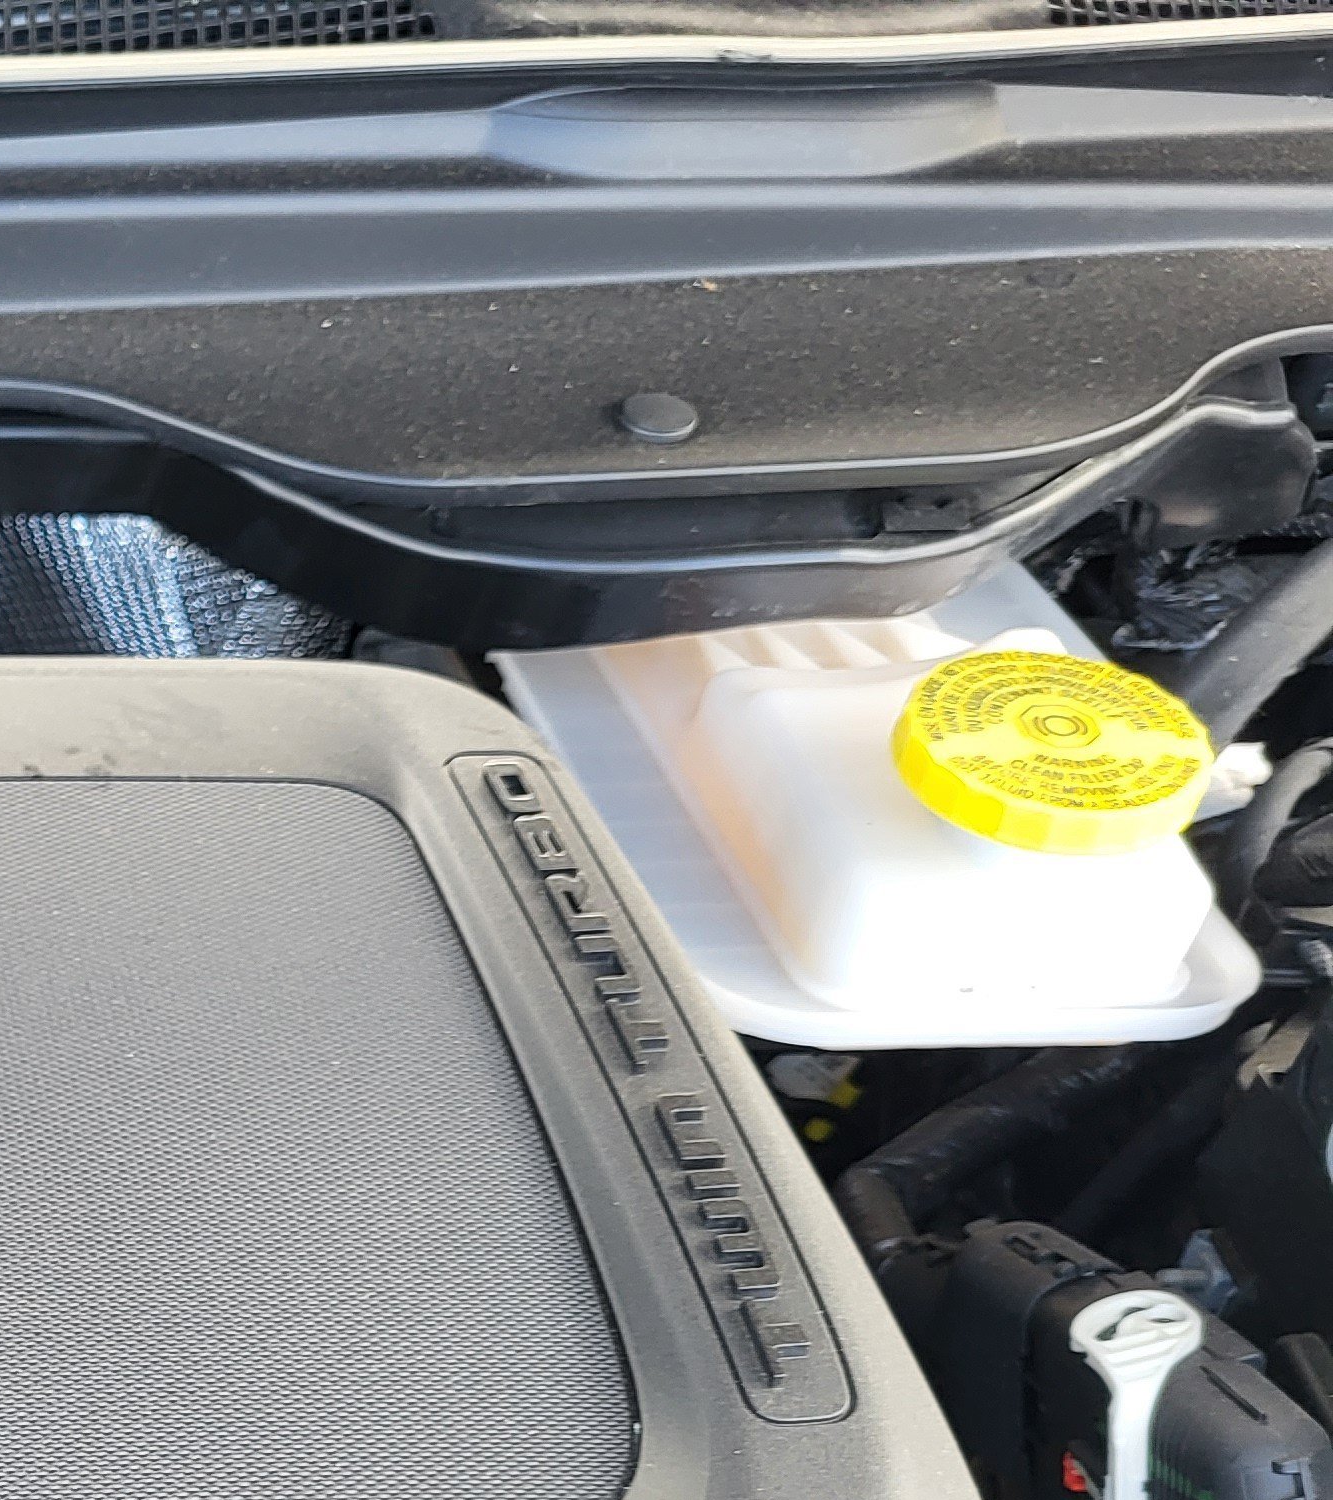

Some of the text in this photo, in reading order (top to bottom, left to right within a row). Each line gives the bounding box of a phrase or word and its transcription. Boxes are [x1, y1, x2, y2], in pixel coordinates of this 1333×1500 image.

[1010, 759, 1065, 781] CLEAN
[1033, 754, 1117, 769] WARNING
[481, 759, 670, 1075] TURBO
